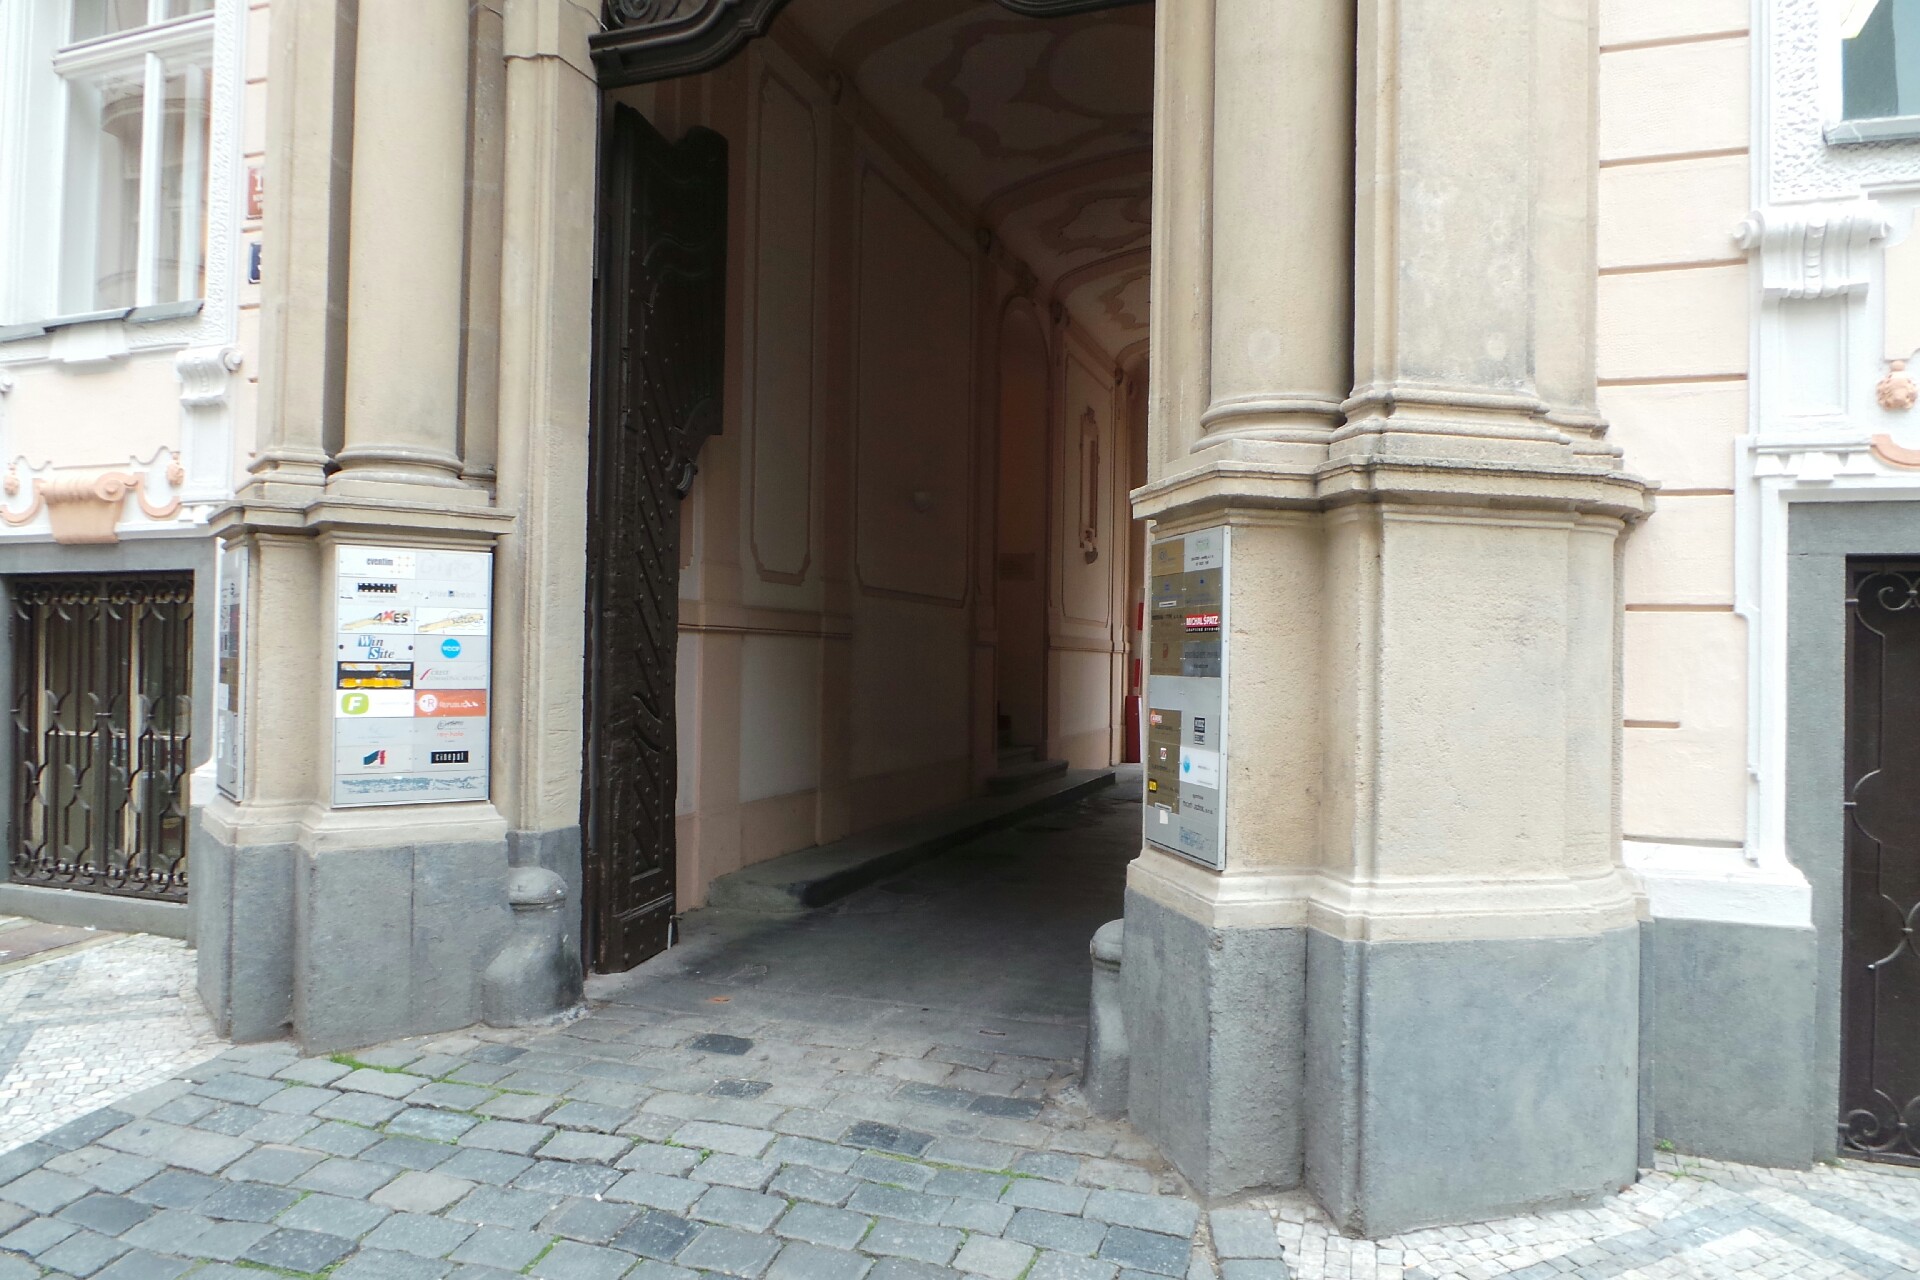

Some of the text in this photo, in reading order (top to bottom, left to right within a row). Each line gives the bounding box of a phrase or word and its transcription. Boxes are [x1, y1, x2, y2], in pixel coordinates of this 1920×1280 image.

[366, 558, 394, 566] eventim
[373, 610, 408, 624] AXES
[1186, 614, 1218, 626] MICHAL ŠPATZ
[358, 635, 384, 647] Win
[368, 647, 395, 660] Site
[435, 752, 464, 763] cinepol
